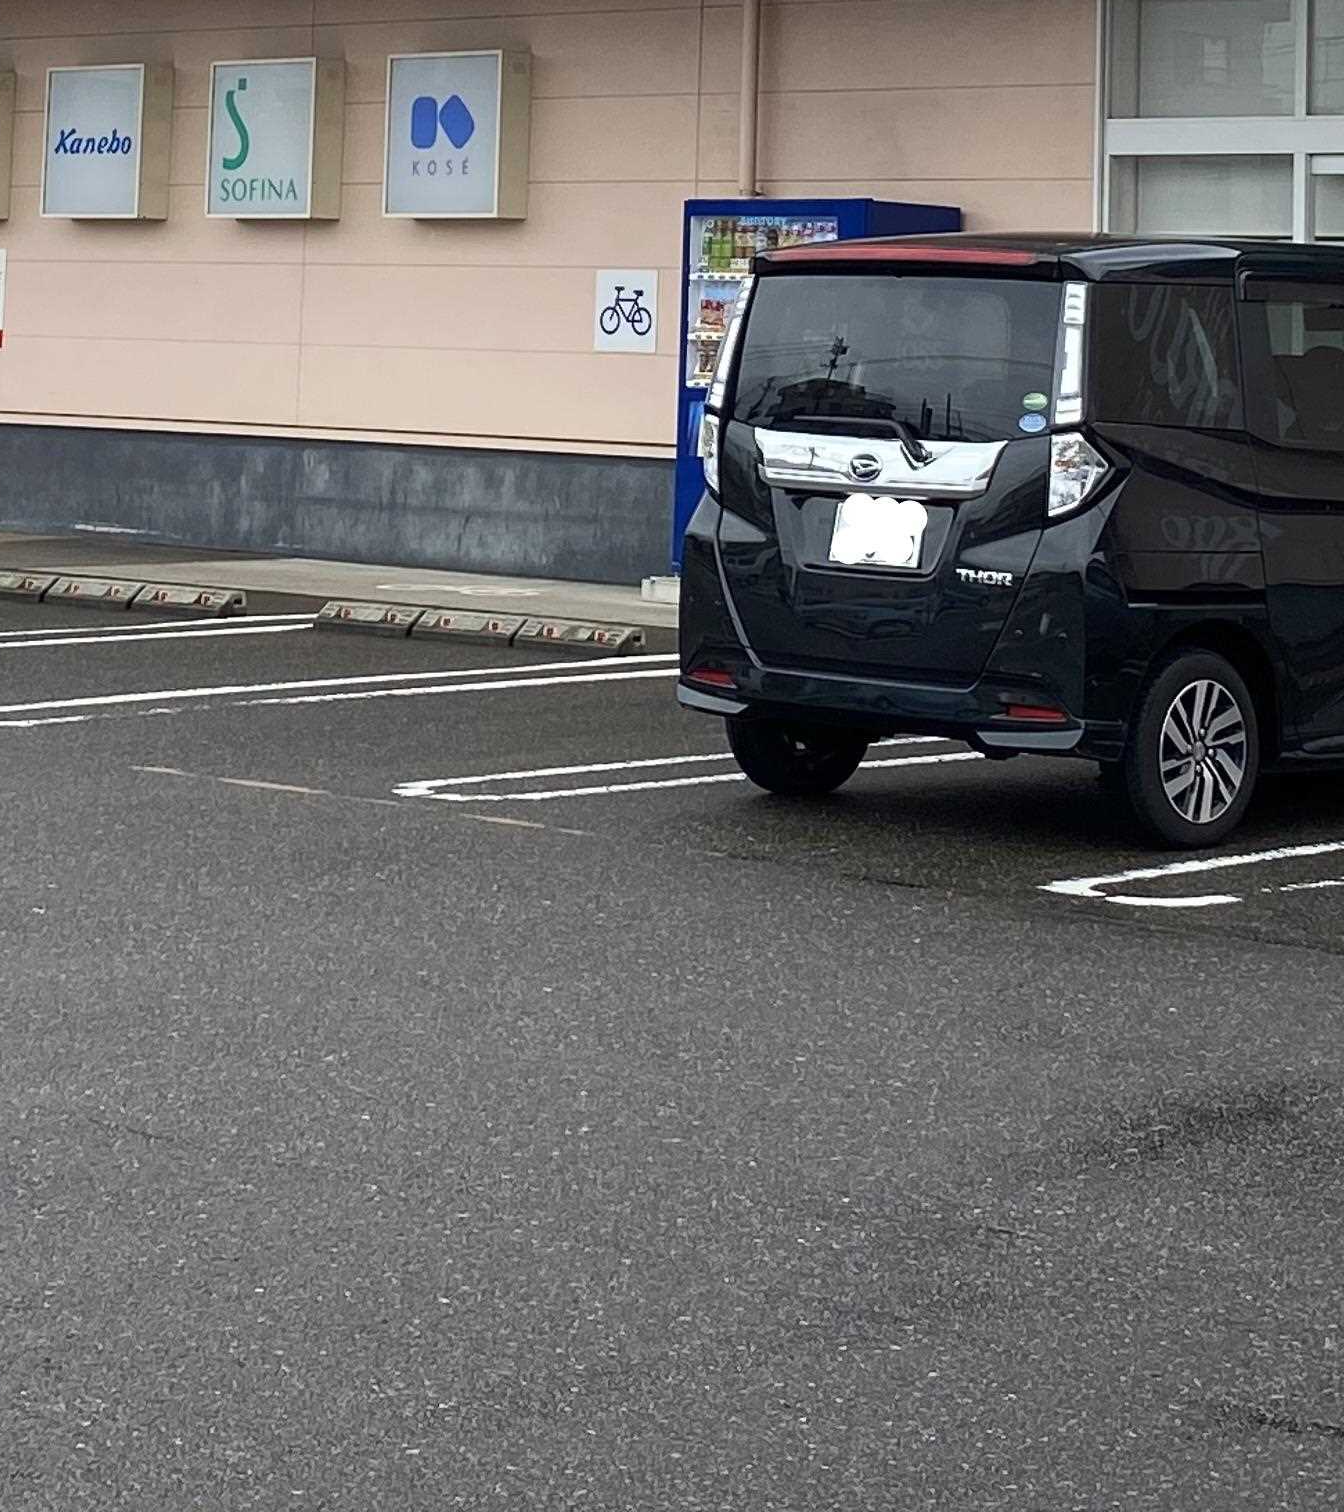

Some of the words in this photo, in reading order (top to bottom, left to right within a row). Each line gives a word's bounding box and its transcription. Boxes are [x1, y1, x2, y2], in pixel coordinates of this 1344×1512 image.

[55, 128, 131, 156] Kanebo
[220, 178, 297, 201] SOFINA
[956, 568, 1013, 586] THOR
